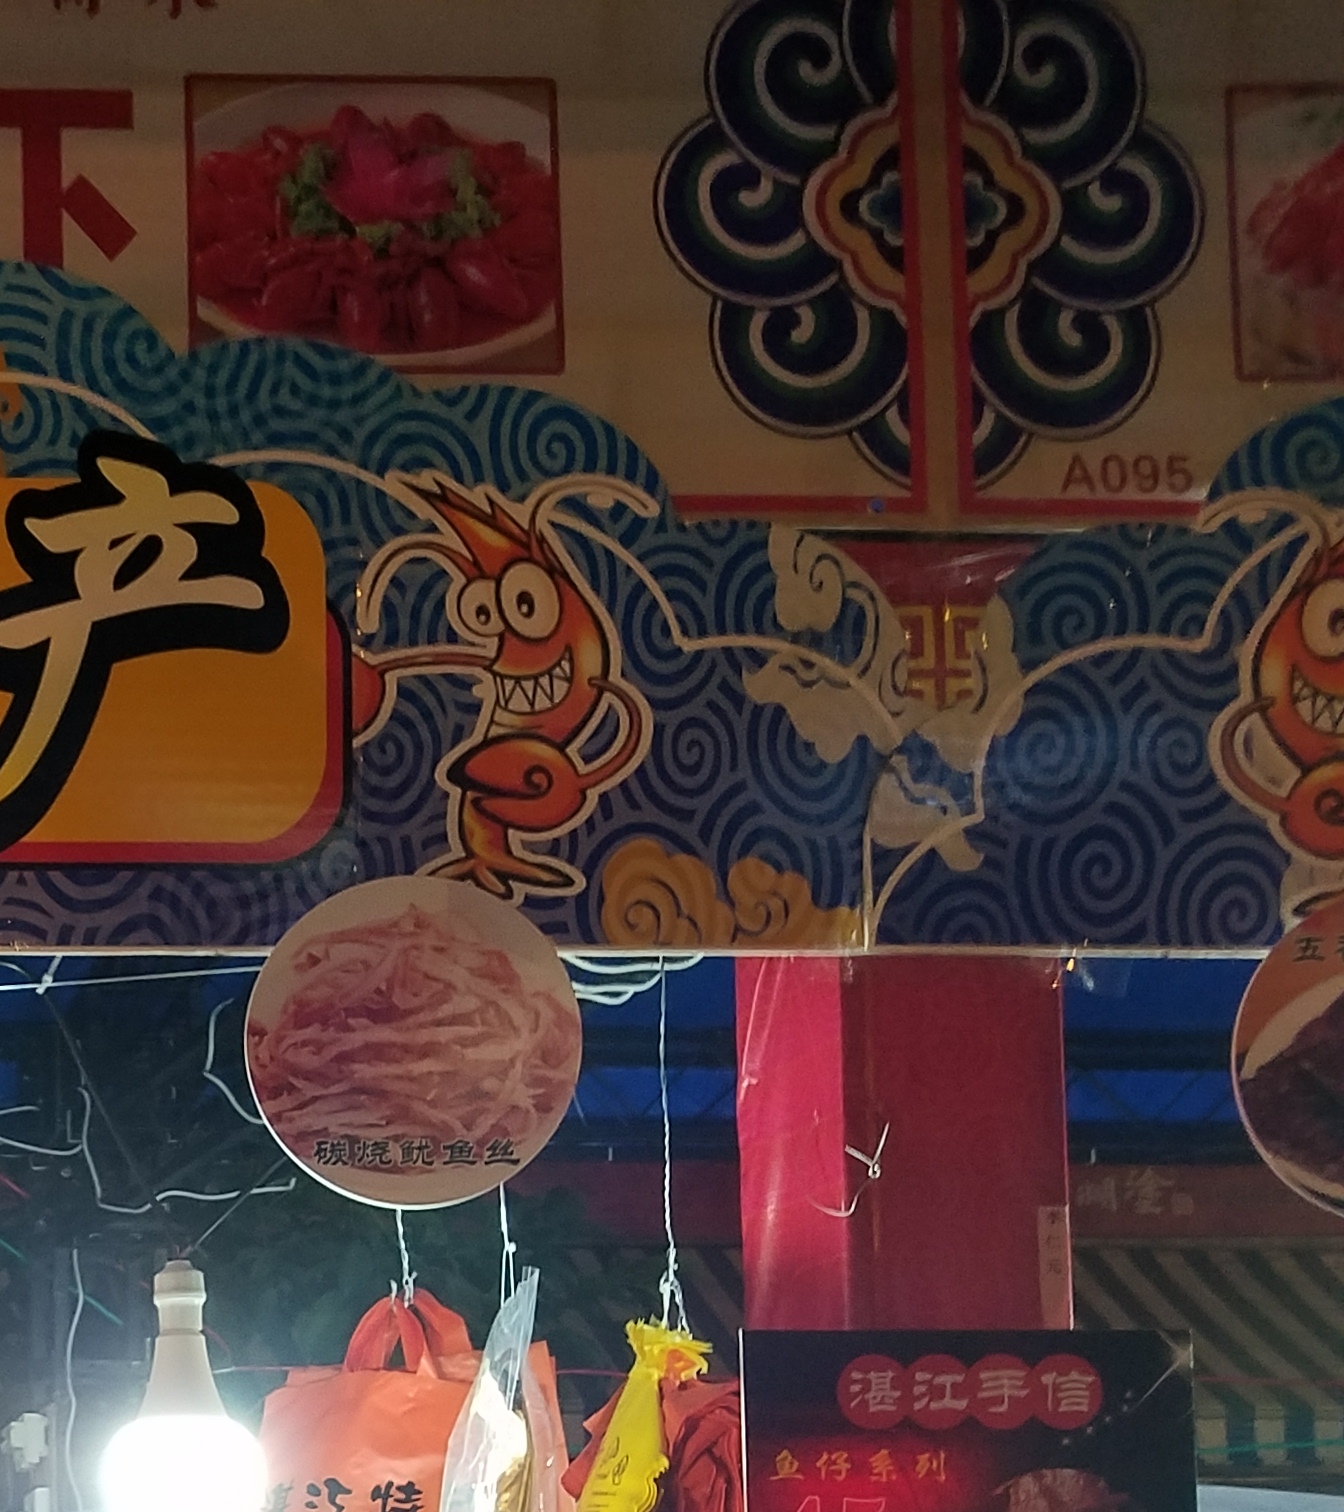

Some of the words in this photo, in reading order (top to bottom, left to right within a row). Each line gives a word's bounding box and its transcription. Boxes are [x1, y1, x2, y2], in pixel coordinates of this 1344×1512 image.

[1061, 455, 1194, 494] A095
[313, 1138, 521, 1168] 碳烧鱿鱼丝
[848, 1368, 1098, 1415] 湛江手信
[768, 1448, 948, 1484] 鱼仔系列
